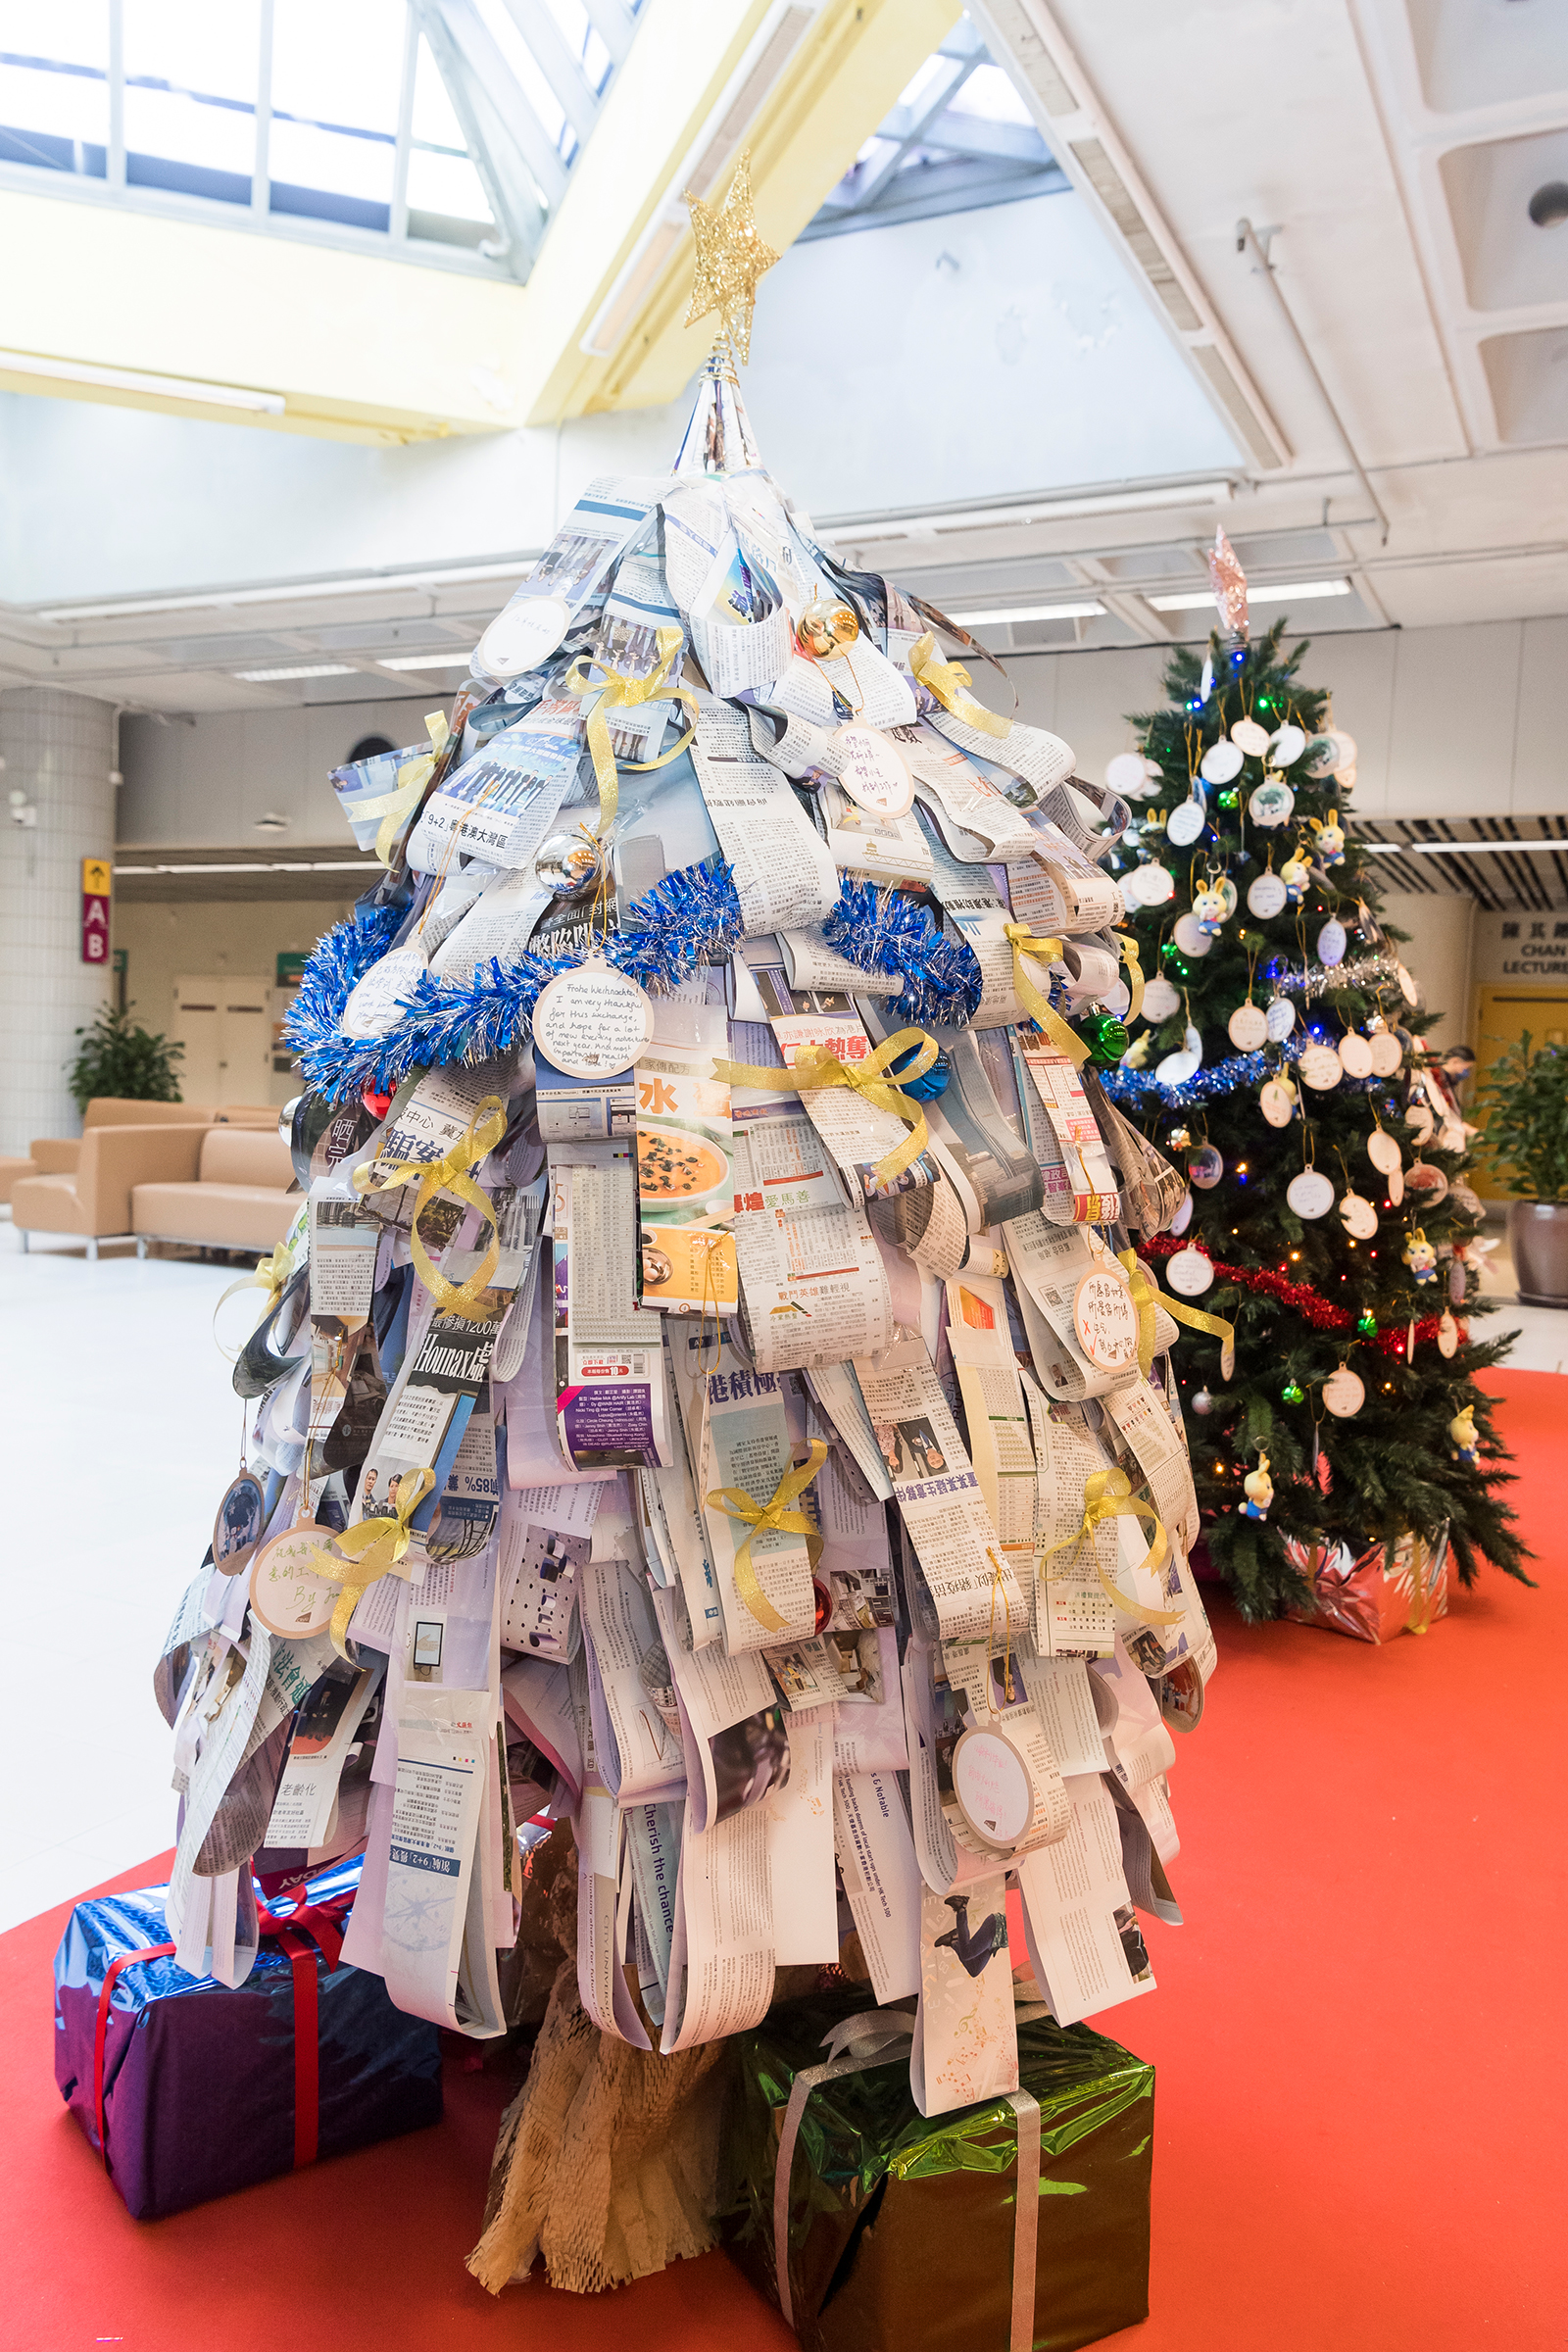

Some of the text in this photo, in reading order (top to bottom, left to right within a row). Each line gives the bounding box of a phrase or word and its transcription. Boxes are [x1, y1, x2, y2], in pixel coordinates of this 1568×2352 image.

[84, 901, 106, 927] A
[87, 934, 105, 957] B
[1521, 943, 1566, 957] CHAN
[566, 984, 588, 994] Frohe
[584, 1000, 602, 1010] very
[604, 999, 643, 1012] thankful
[549, 1007, 565, 1021] for
[546, 1031, 556, 1040] of
[569, 1022, 592, 1033] hope
[598, 1023, 611, 1035] for
[646, 1059, 690, 1075] 家傳配方
[638, 1077, 679, 1114] 水
[285, 1586, 316, 1612] By
[844, 1778, 856, 1798] funding
[872, 1778, 882, 1787] &
[839, 1788, 848, 1799] Tech
[851, 1797, 860, 1813] backs
[874, 1787, 890, 1819] Notable
[855, 1812, 865, 1831] dozens
[861, 1836, 871, 1849] local
[643, 1802, 673, 1934] Cherish the chance
[864, 1849, 878, 1873] start-ups
[873, 1872, 882, 1887] under
[878, 1886, 885, 1895] HK
